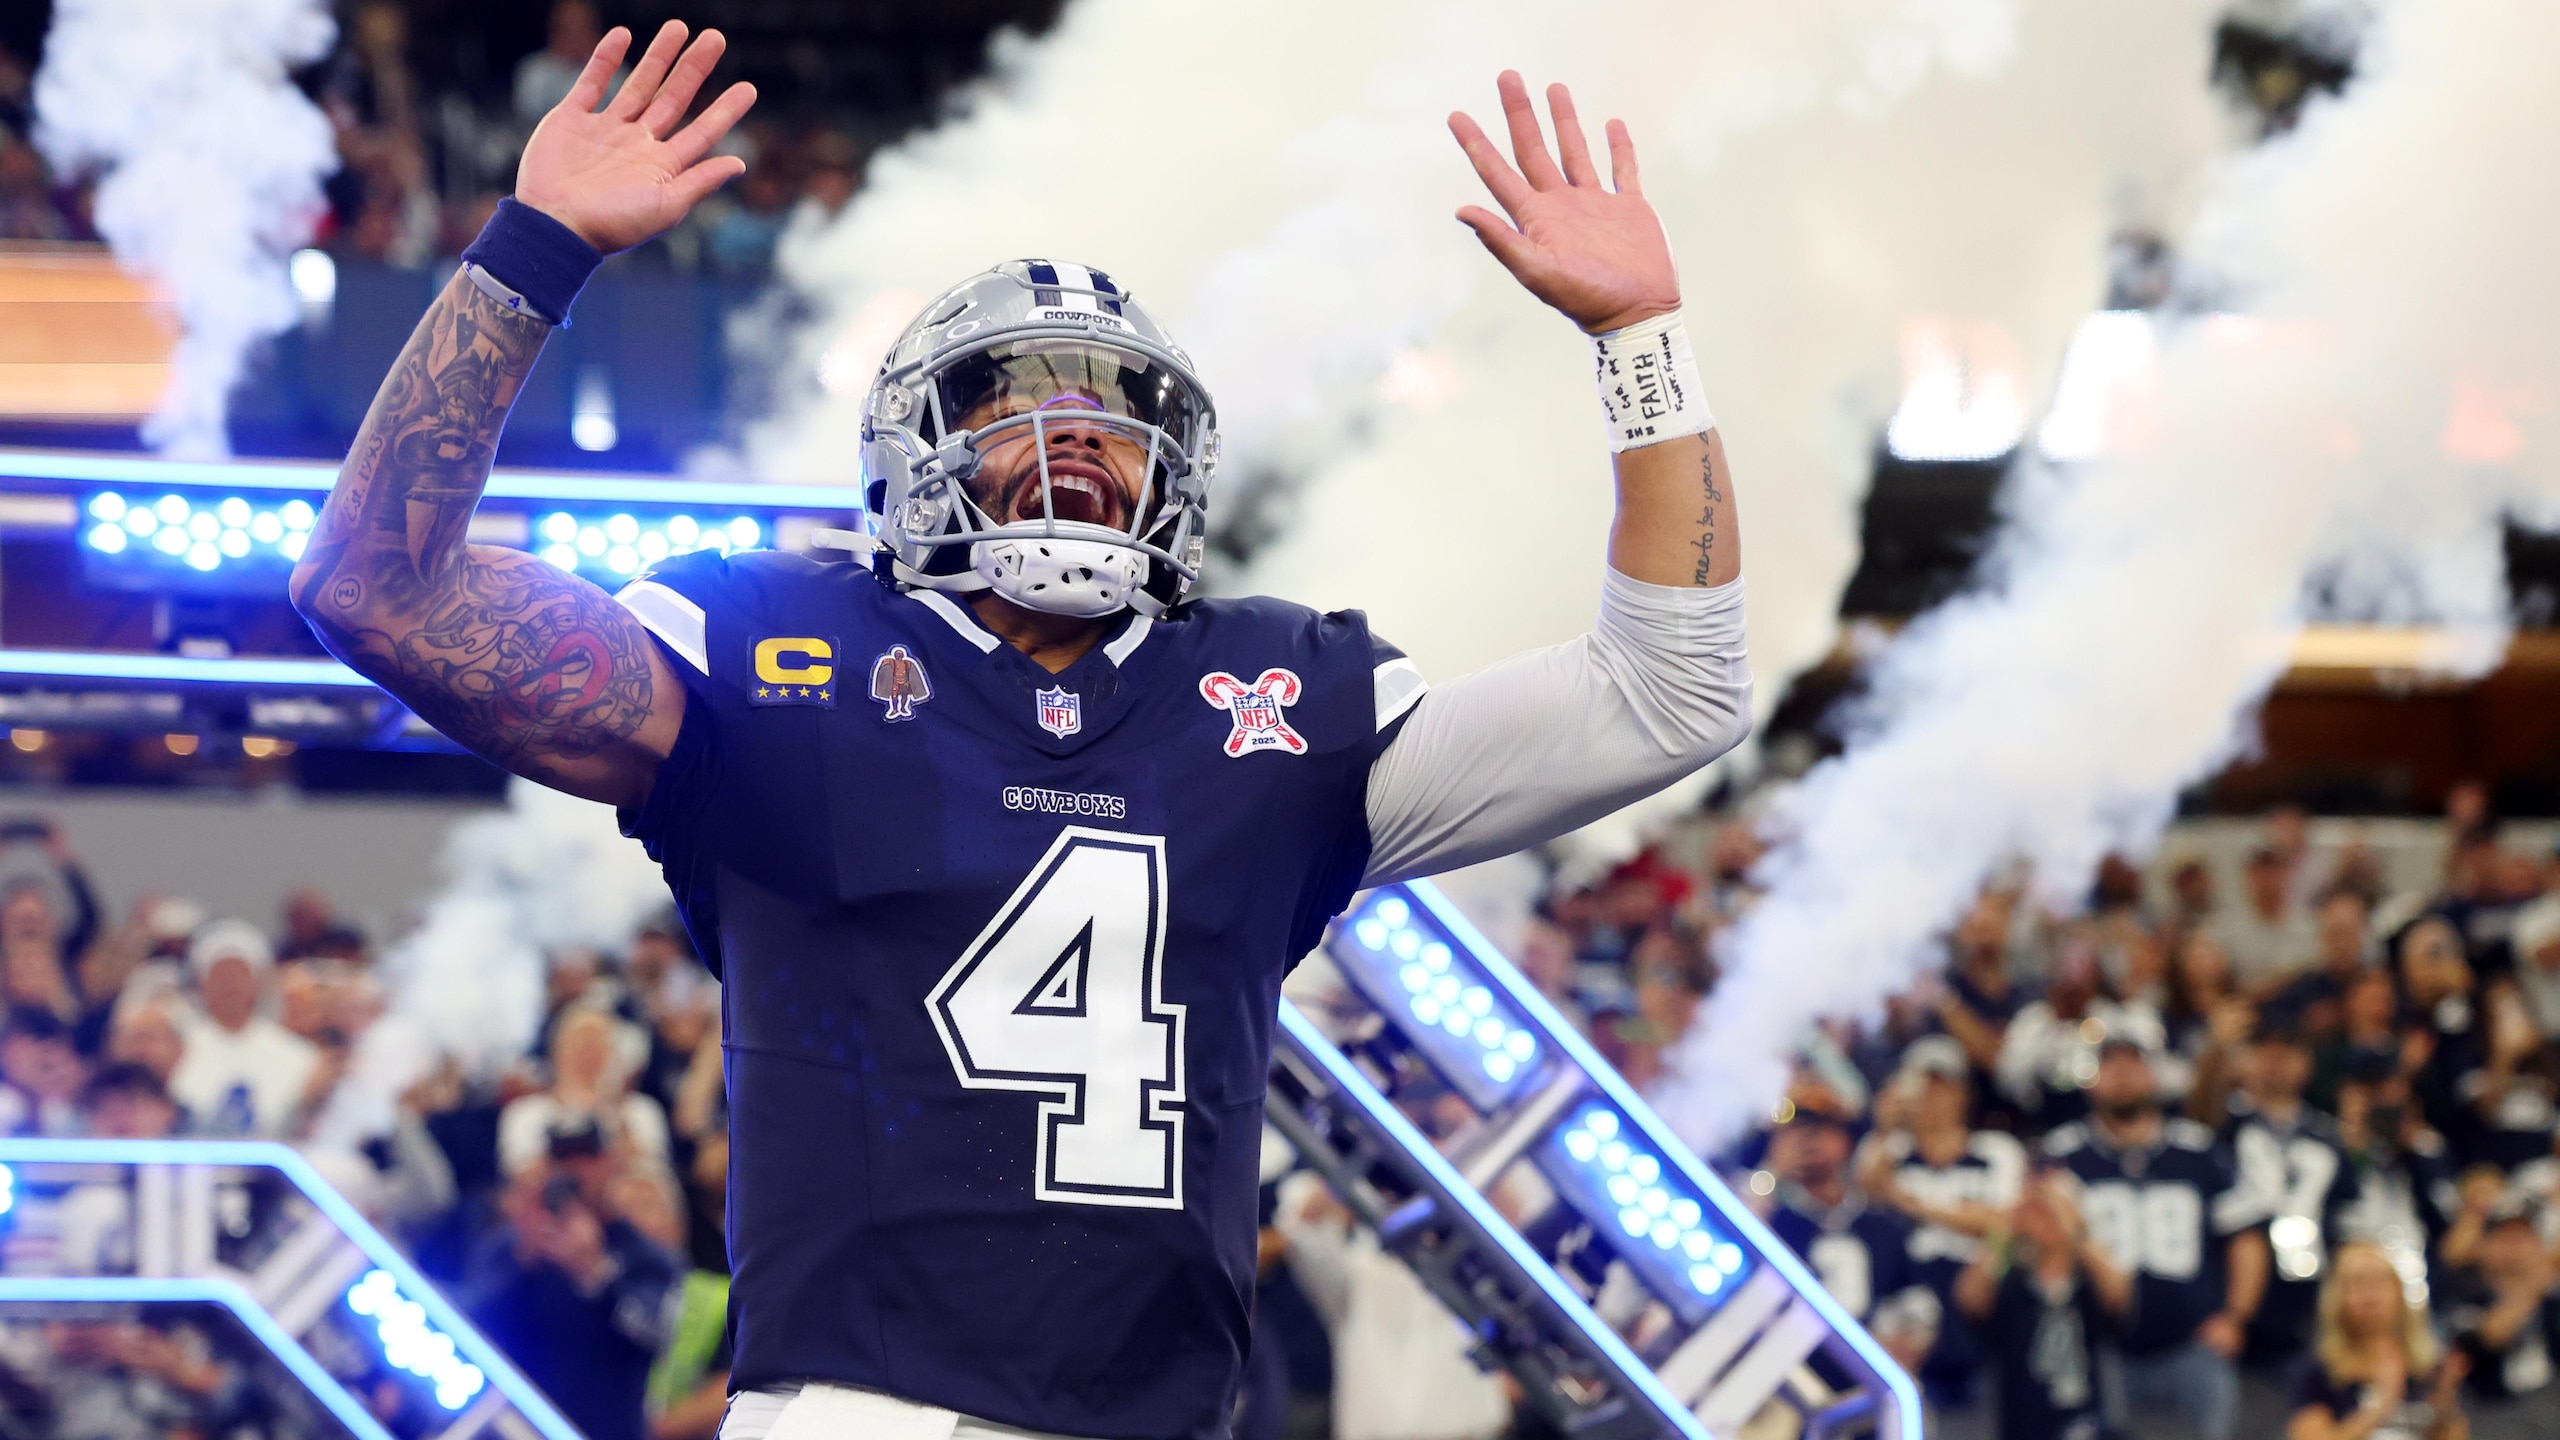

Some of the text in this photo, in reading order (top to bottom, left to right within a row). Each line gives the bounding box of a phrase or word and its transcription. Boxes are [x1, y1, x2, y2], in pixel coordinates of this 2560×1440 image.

[1044, 311, 1122, 329] COWBOYS
[1632, 353, 1666, 420] FAITH
[1700, 453, 1721, 502] your
[1696, 505, 1714, 527] be
[1690, 532, 1714, 554] to
[754, 637, 833, 686] C
[1044, 707, 1074, 728] NFL
[1240, 709, 1275, 728] NFL
[1251, 737, 1276, 745] 2025
[1003, 786, 1126, 819] COWBOYS
[923, 824, 1187, 1210] 4
